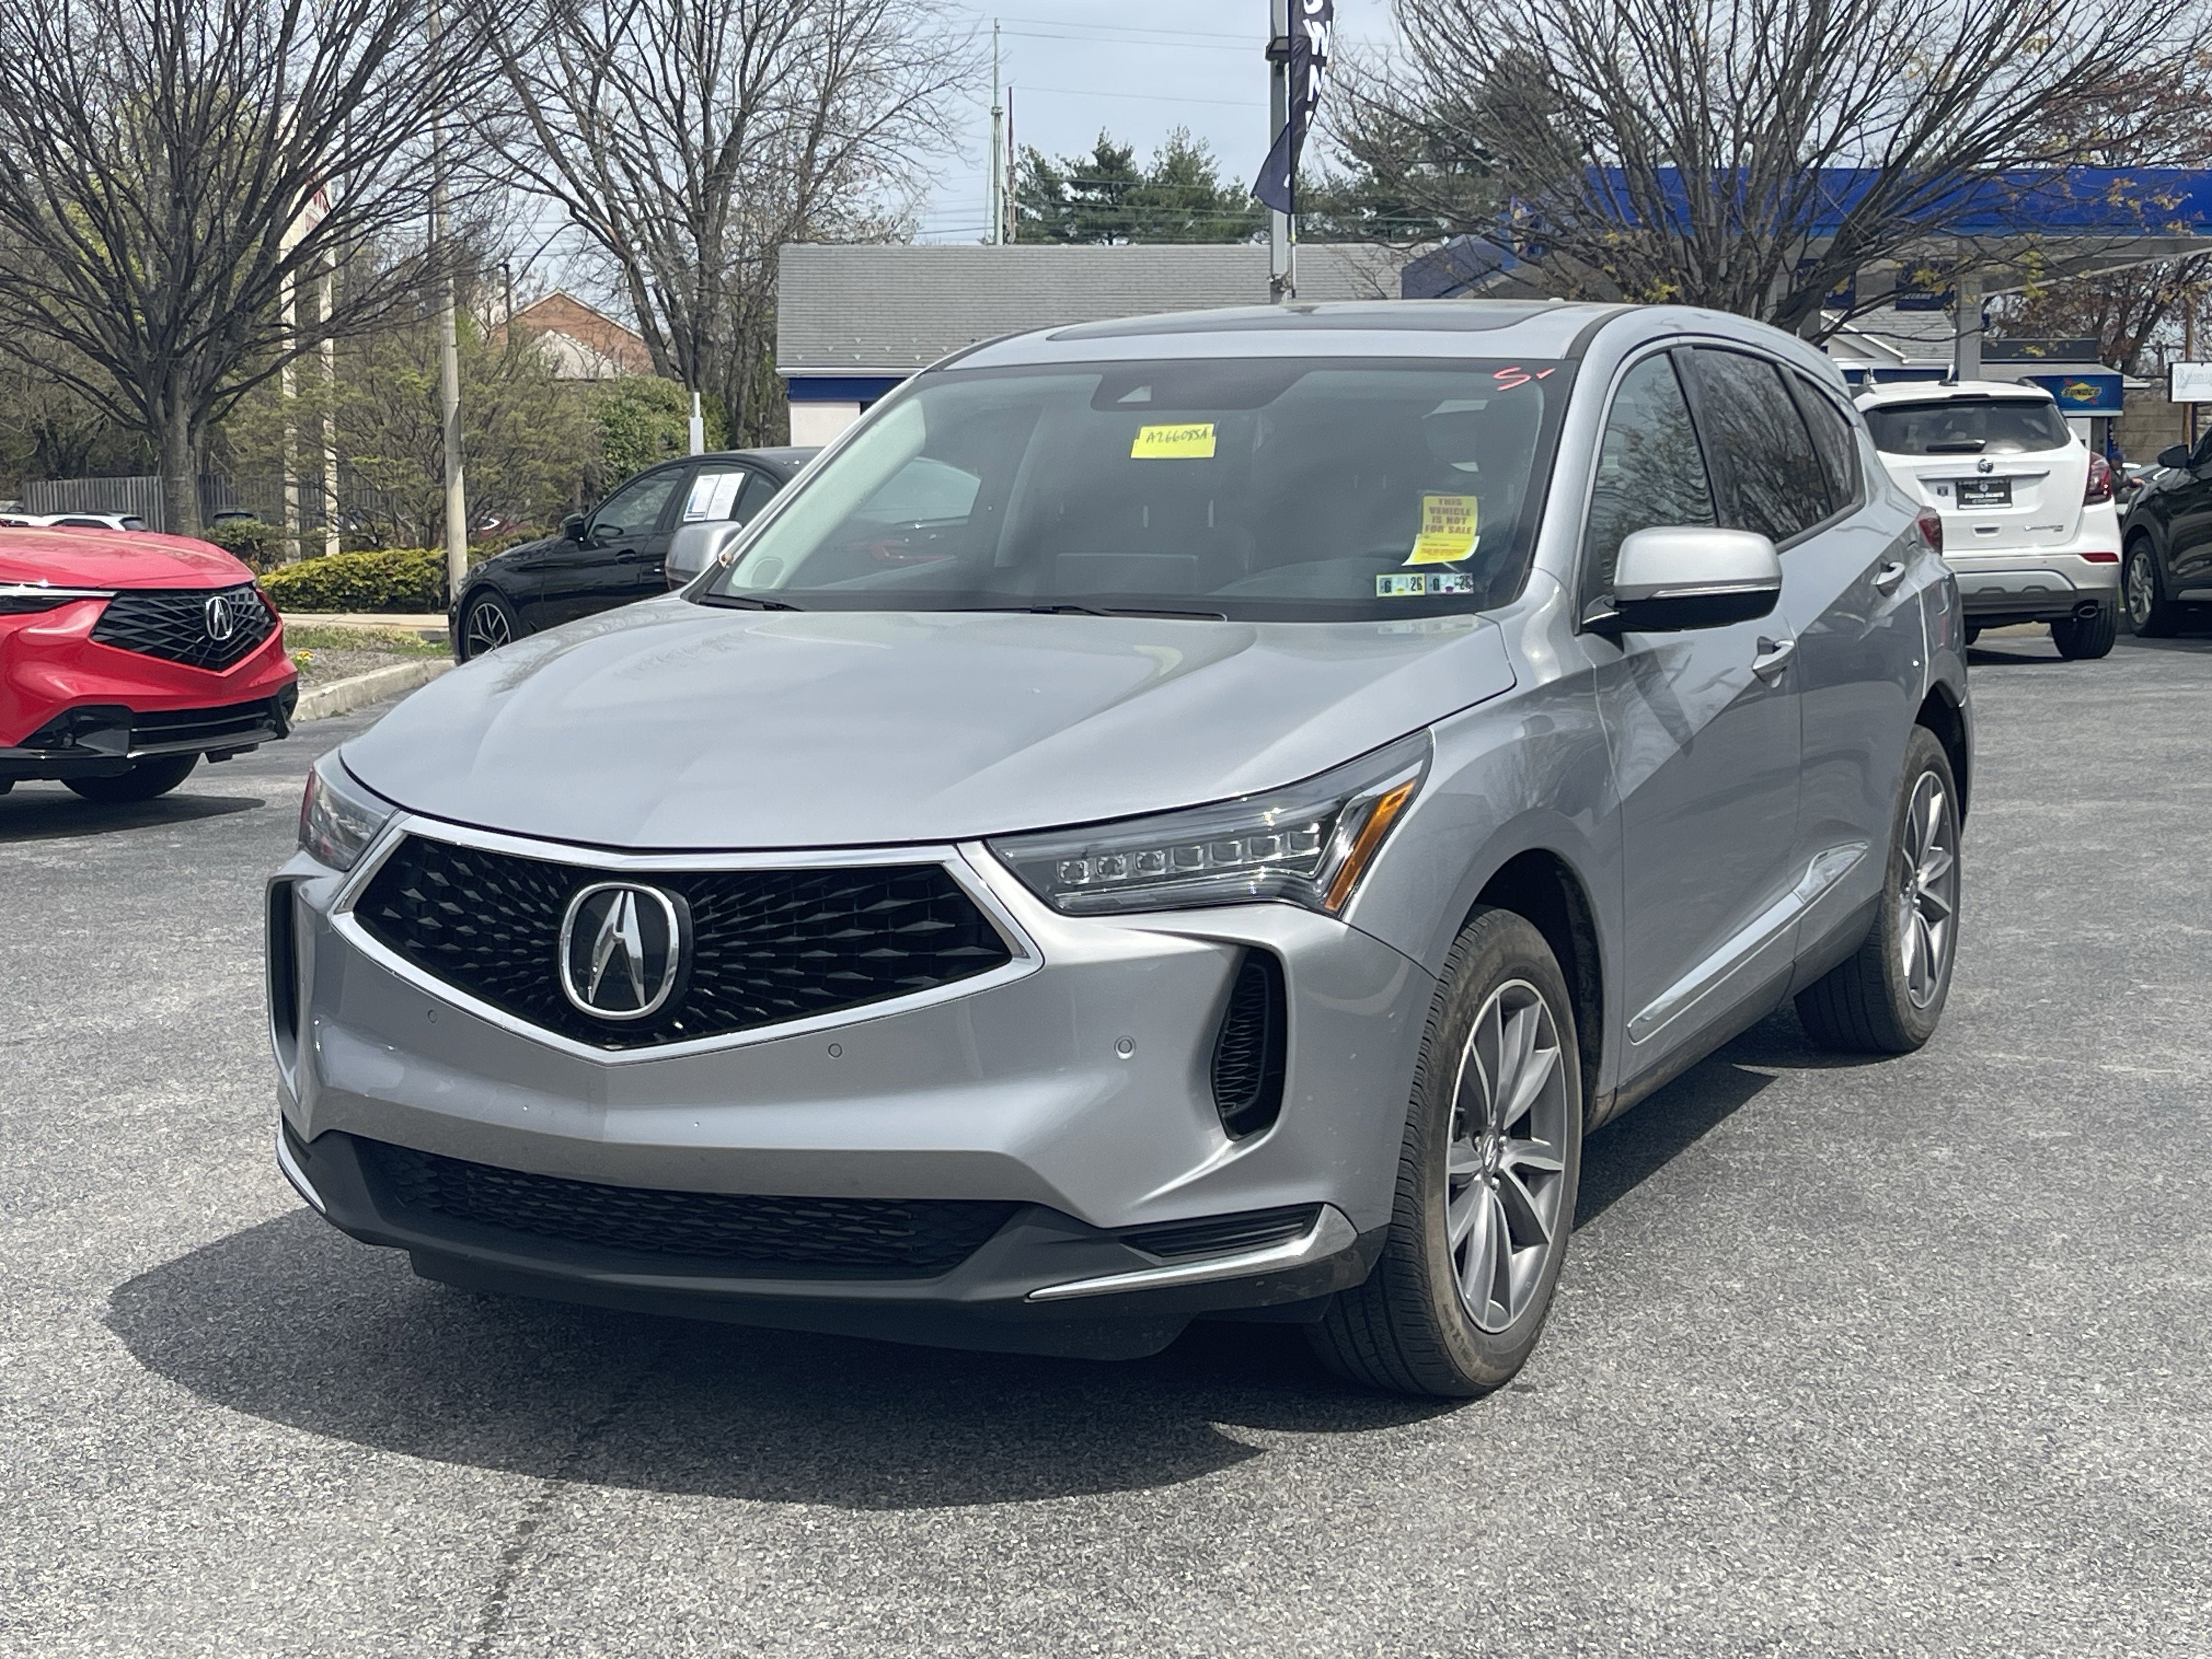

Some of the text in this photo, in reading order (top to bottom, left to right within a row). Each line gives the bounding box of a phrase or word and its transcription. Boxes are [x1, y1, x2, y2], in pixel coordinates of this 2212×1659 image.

[1429, 507, 1471, 516] VEHICLE
[1432, 515, 1466, 524] IS NOT
[1425, 524, 1472, 534] FOR SALE
